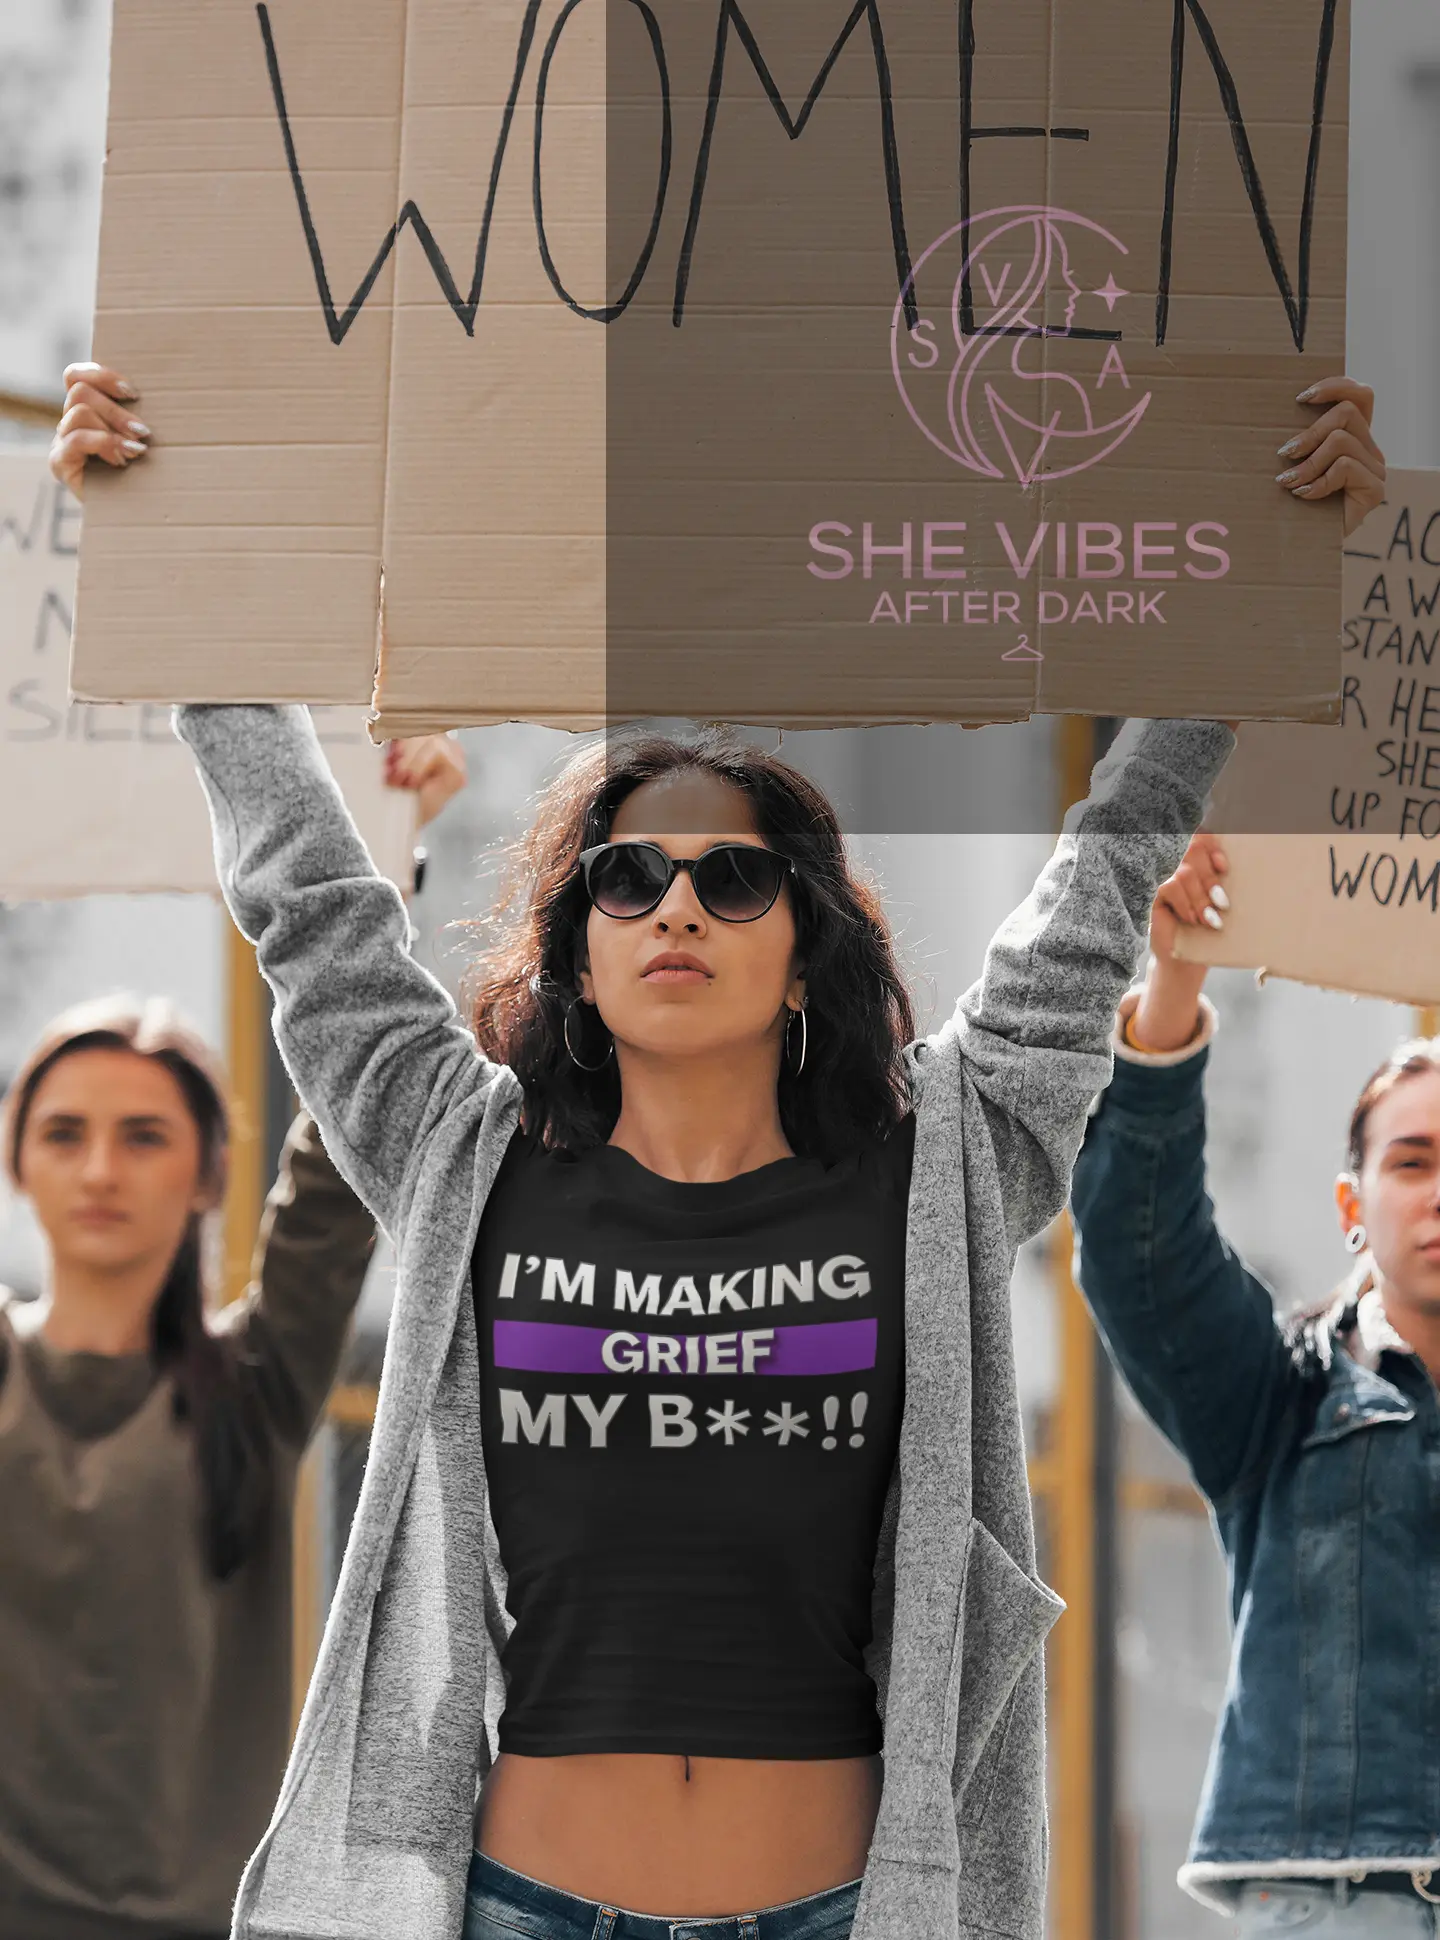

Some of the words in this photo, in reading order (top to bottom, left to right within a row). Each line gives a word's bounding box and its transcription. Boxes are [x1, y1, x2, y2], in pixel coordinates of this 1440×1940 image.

[256, 0, 1336, 353] WOMEN
[1363, 573, 1390, 614] A
[1331, 785, 1380, 830] UP
[613, 1254, 872, 1317] MAKING
[601, 1328, 776, 1375] GRIEF
[498, 1387, 628, 1449] MY
